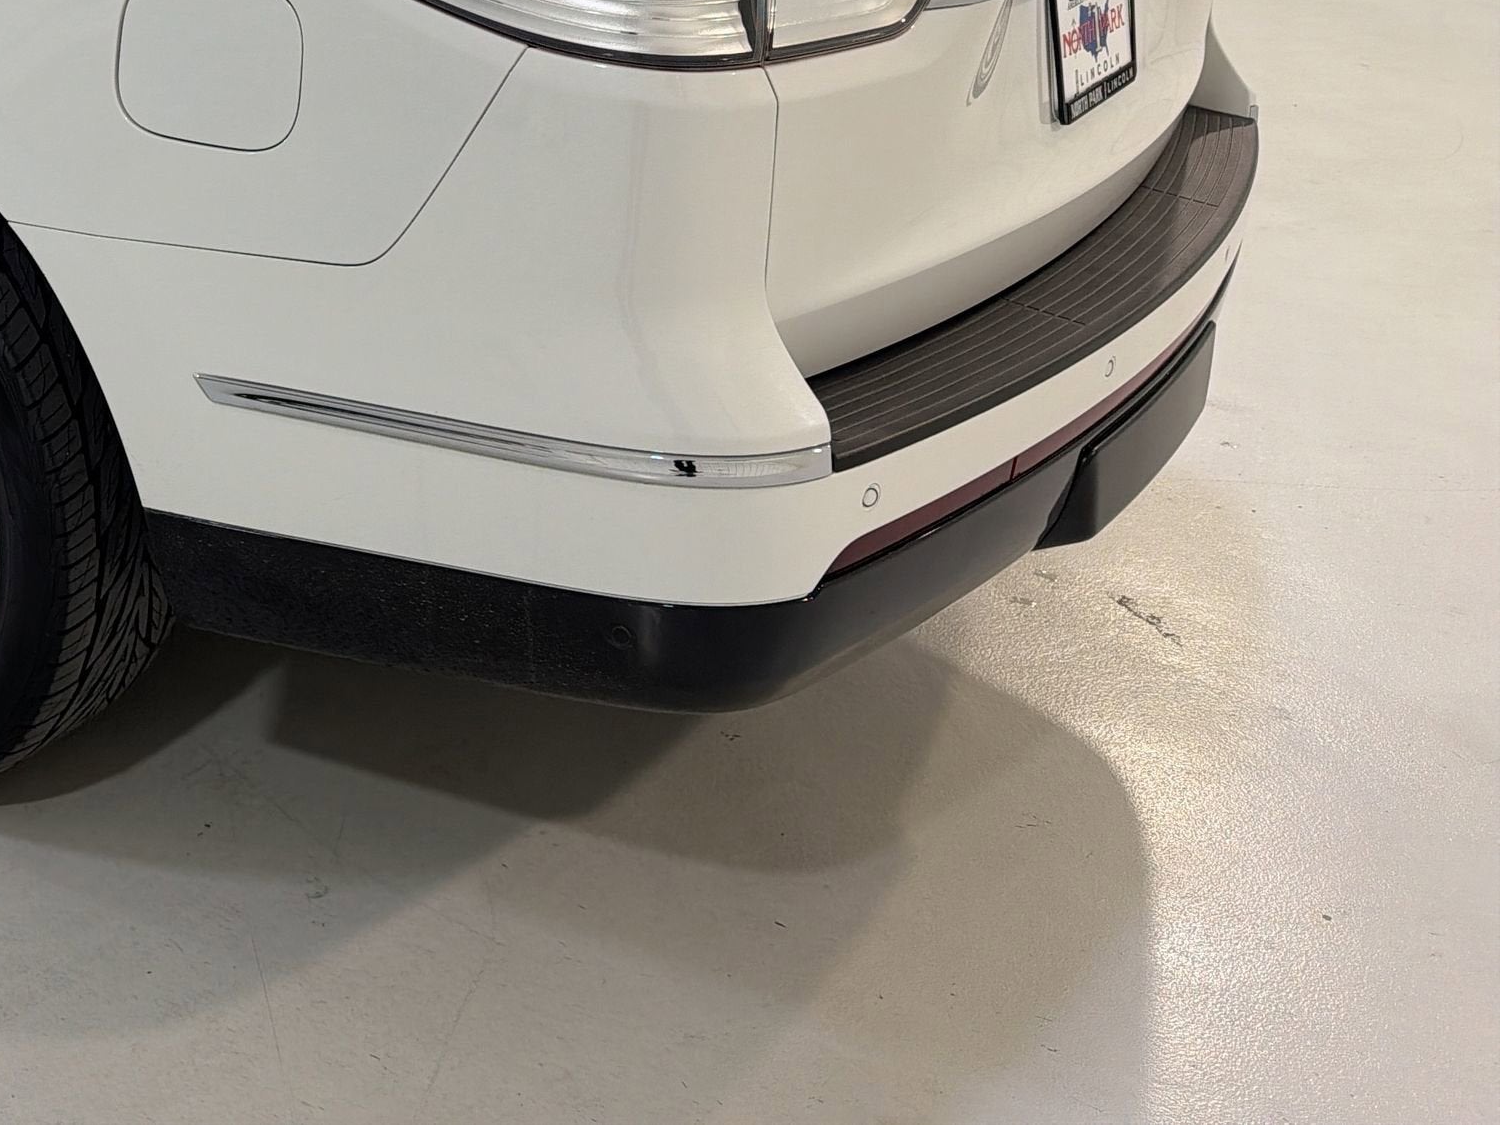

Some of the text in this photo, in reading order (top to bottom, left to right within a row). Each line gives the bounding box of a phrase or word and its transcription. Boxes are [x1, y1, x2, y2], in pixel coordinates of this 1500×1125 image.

[1063, 3, 1125, 58] NORTH PARK
[1080, 53, 1120, 87] LINCOLN
[1088, 85, 1104, 108] PARK
[1107, 66, 1134, 94] LINCOLN
